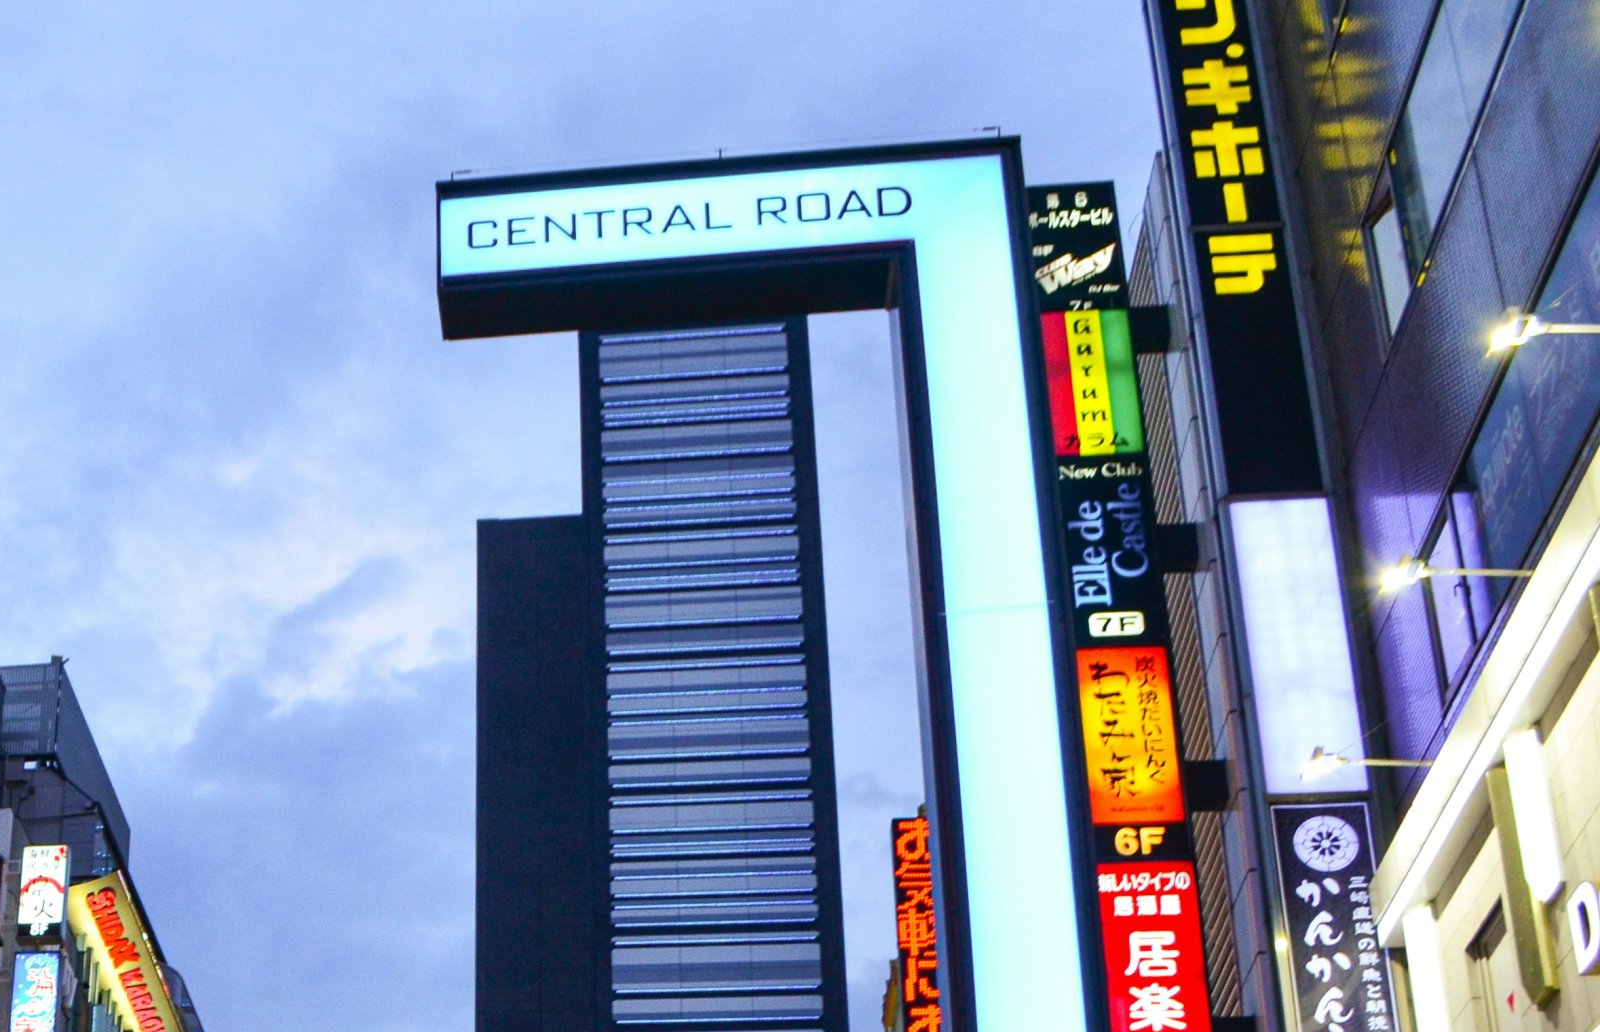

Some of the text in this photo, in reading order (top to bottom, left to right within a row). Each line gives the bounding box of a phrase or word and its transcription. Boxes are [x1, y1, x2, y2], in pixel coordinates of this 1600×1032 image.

[466, 185, 913, 250] CENTRAL ROAD
[1059, 462, 1143, 480] New Club
[1107, 481, 1149, 578] Castle
[1068, 500, 1113, 608] Elle de
[1096, 616, 1139, 633] 7F
[1114, 827, 1166, 856] 6F
[1098, 871, 1191, 893] 新しいタイプの
